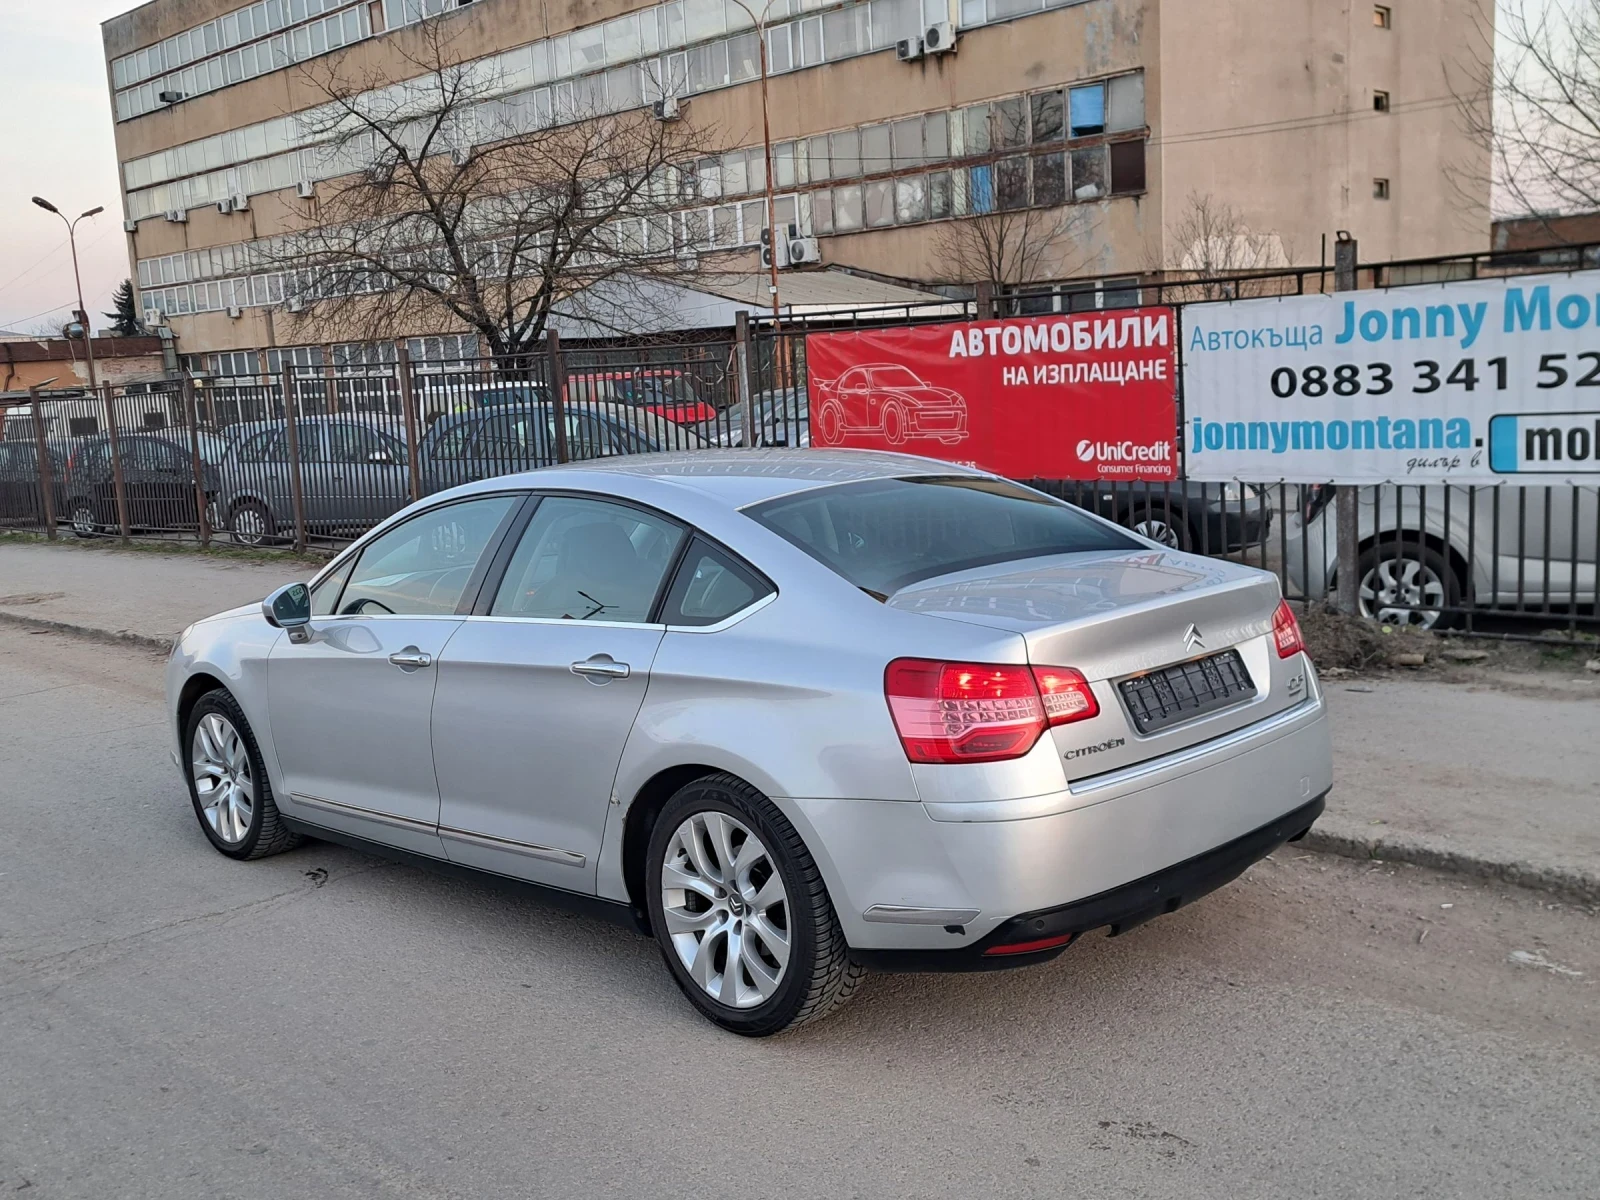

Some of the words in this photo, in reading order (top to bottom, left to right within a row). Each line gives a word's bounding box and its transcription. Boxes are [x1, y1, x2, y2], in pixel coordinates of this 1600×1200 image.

[1190, 325, 1323, 351] Автокъща
[1334, 300, 1488, 349] Jonny
[1503, 285, 1600, 333] Mo
[949, 315, 1168, 358] АВТОМОБИЛИ
[1003, 366, 1029, 386] НА
[1033, 359, 1167, 387] ИЗПЛАЩАНЕ
[1270, 362, 1394, 398] 0883
[1411, 356, 1507, 394] 341
[1096, 441, 1171, 461] UniCredit
[1192, 415, 1484, 454] jonnymontana.
[1525, 419, 1600, 461] mo
[1097, 464, 1134, 474] Consumer
[1135, 464, 1172, 476] Financing
[1406, 455, 1461, 475] дилър
[1470, 449, 1483, 469] в
[1063, 737, 1126, 761] CITROËN
